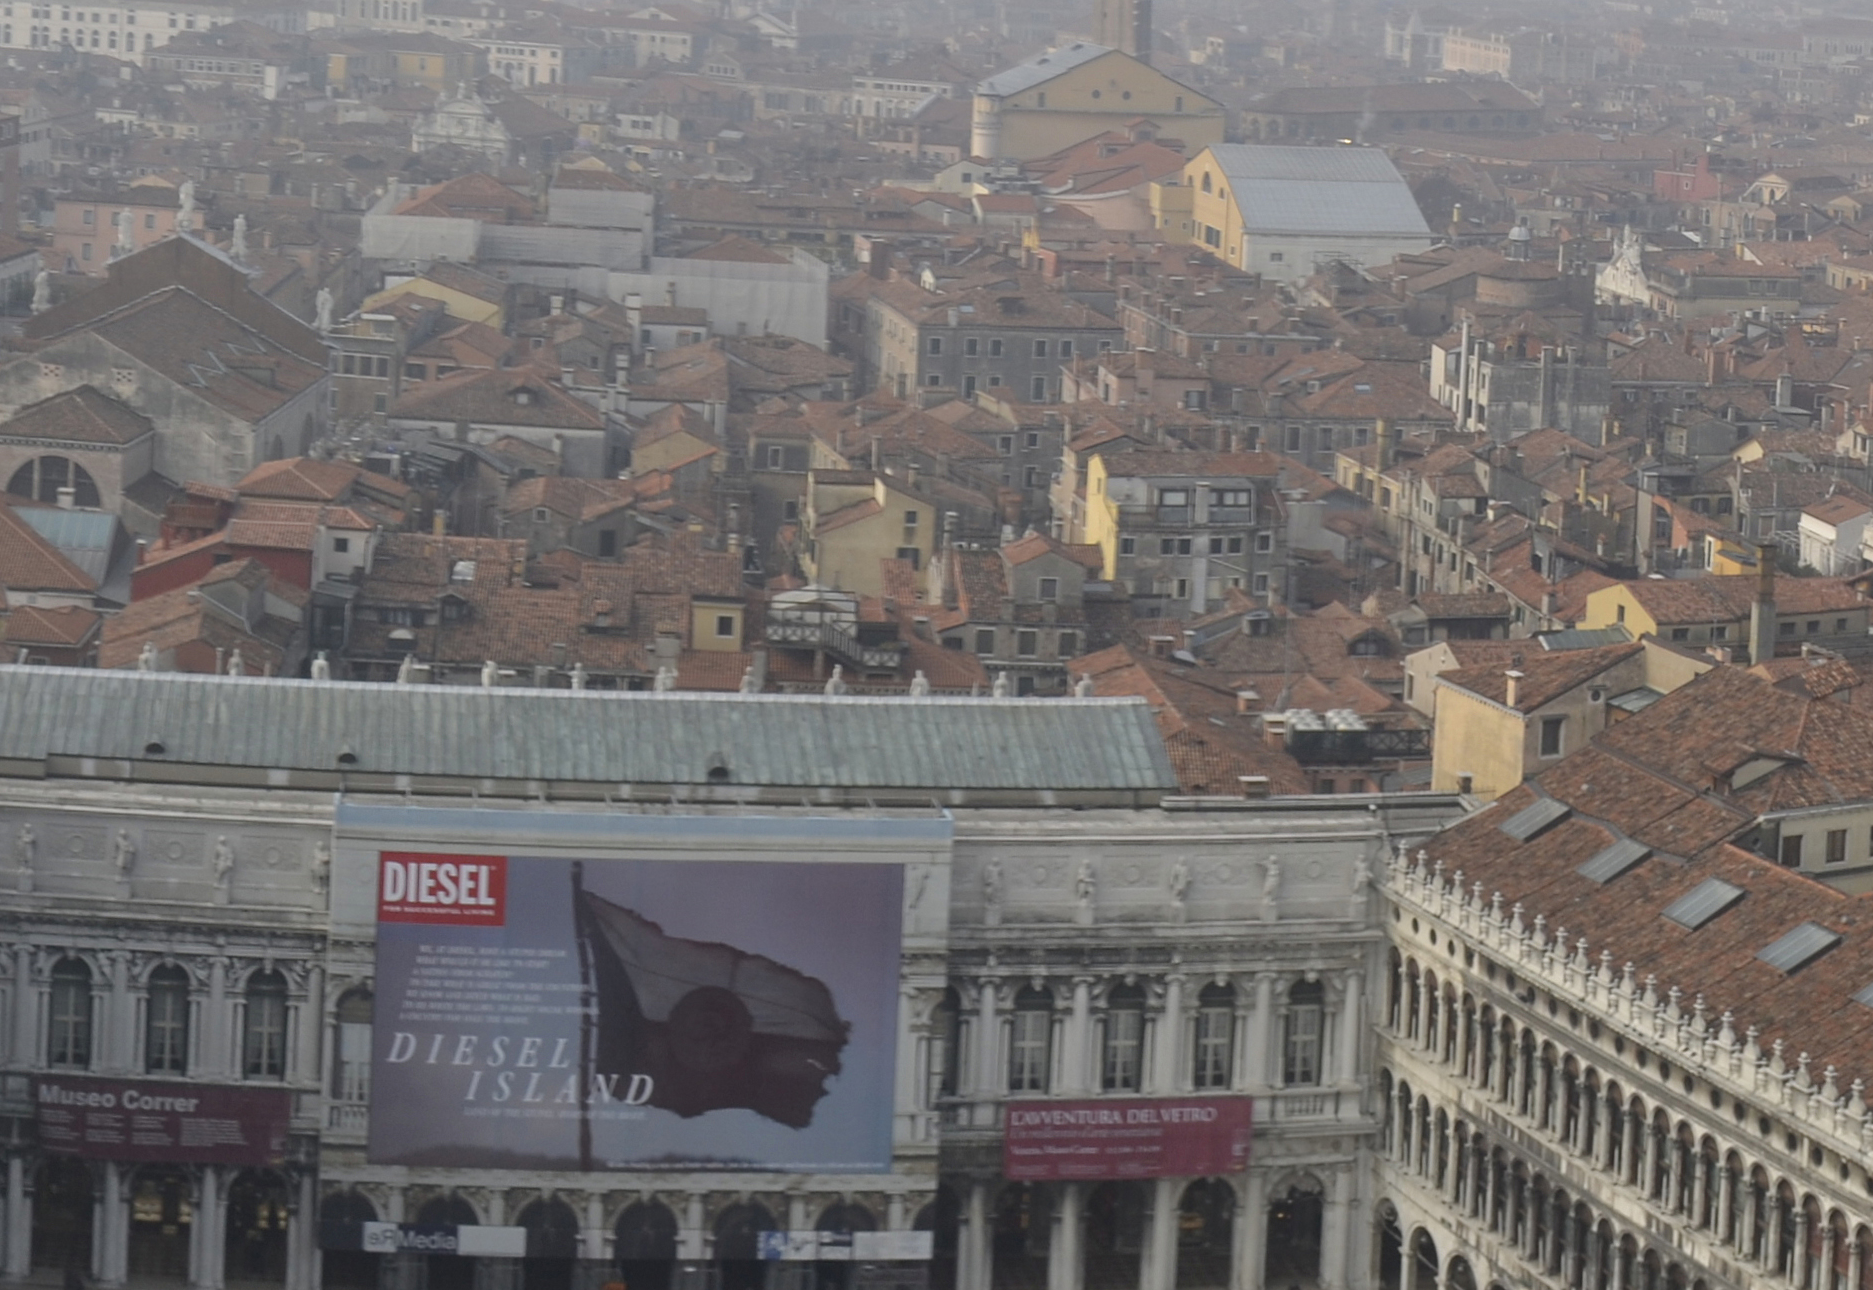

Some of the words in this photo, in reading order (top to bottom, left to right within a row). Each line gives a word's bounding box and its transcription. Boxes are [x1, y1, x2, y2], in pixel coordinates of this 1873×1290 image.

[383, 861, 496, 906] DIESEL
[385, 1031, 570, 1069] DIESEL
[38, 1083, 116, 1109] Museo
[121, 1089, 201, 1113] Correr
[463, 1070, 655, 1106] ISLAND
[1126, 1108, 1161, 1125] DEL
[1159, 1106, 1218, 1123] VETRO
